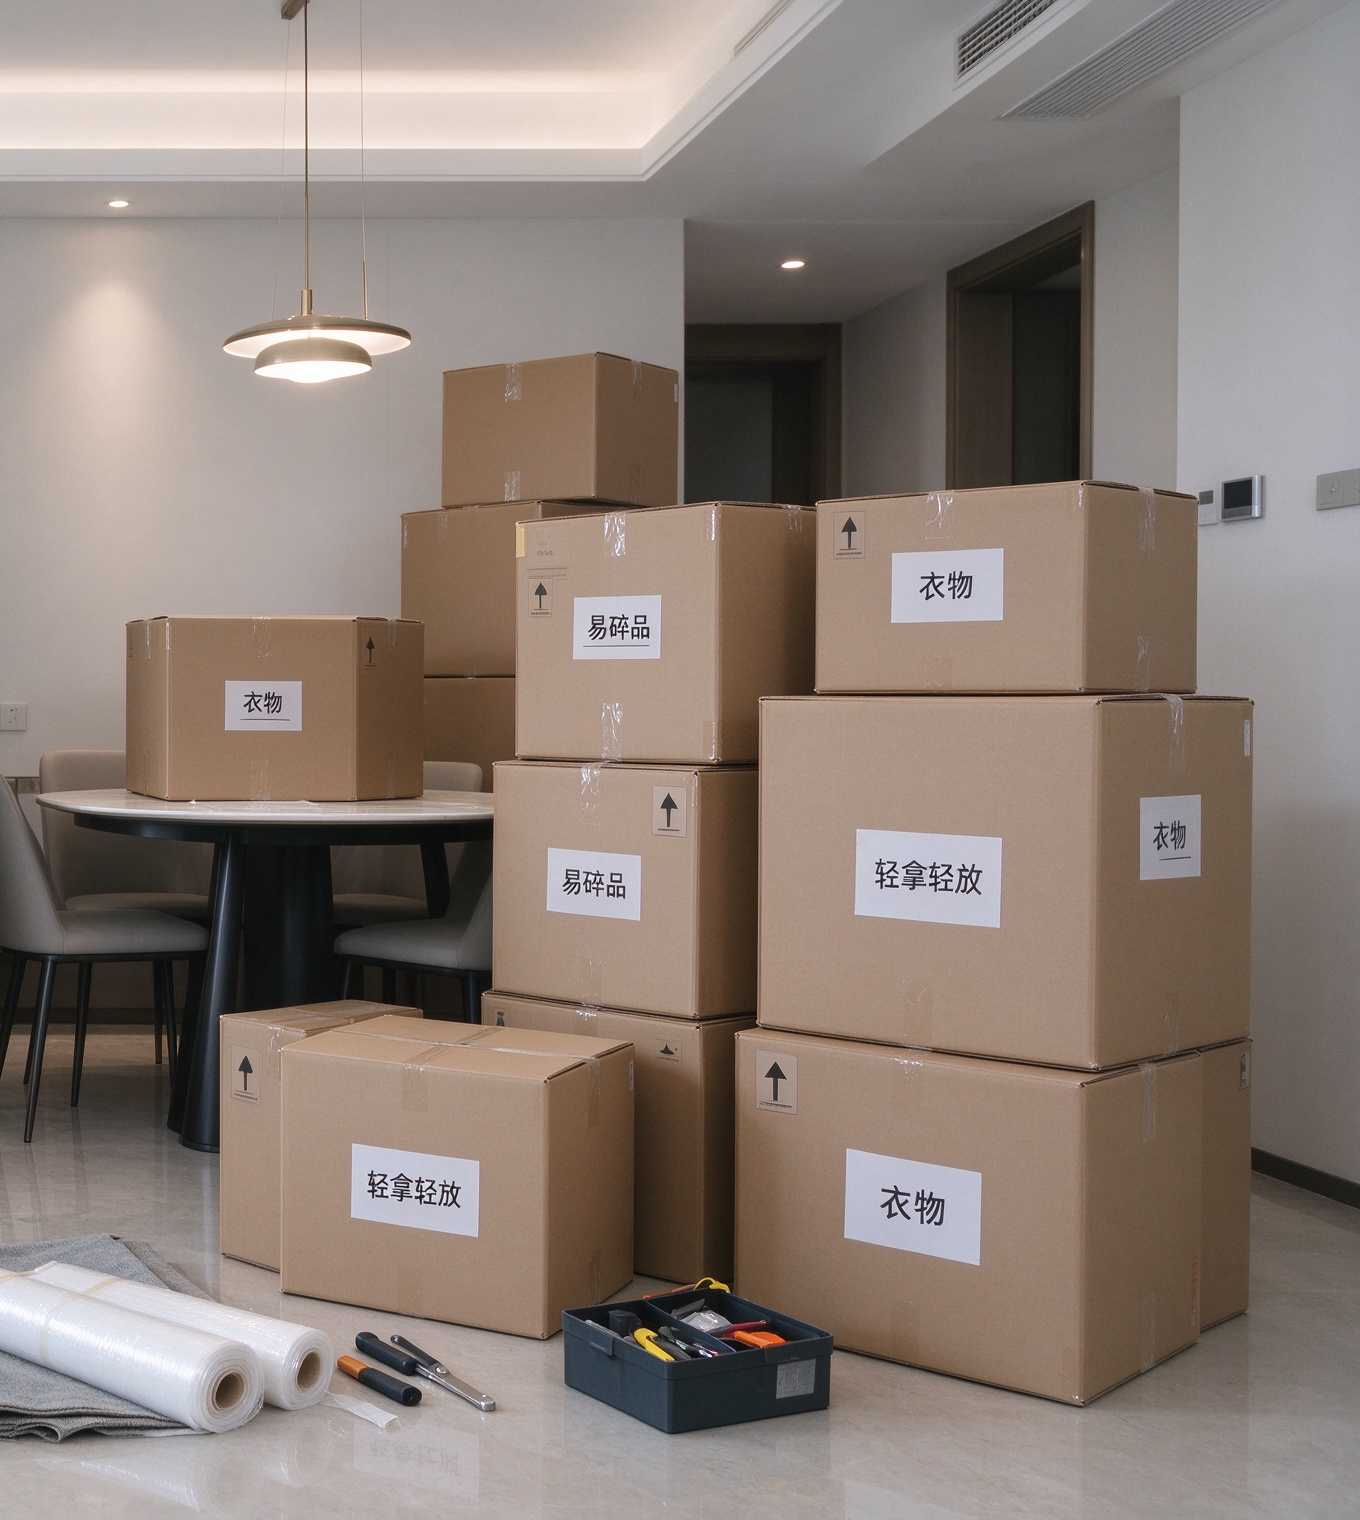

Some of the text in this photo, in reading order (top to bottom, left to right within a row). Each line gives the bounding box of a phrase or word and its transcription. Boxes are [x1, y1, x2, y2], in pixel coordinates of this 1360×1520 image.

[920, 570, 973, 601] 衣物
[587, 613, 650, 641] 易碎品
[243, 690, 283, 714] 衣物
[1153, 820, 1187, 850] 衣物
[563, 869, 626, 899] 易碎品
[875, 859, 983, 895] 轻拿轻放
[367, 1170, 462, 1209] 轻拿轻放
[880, 1185, 945, 1227] 衣物
